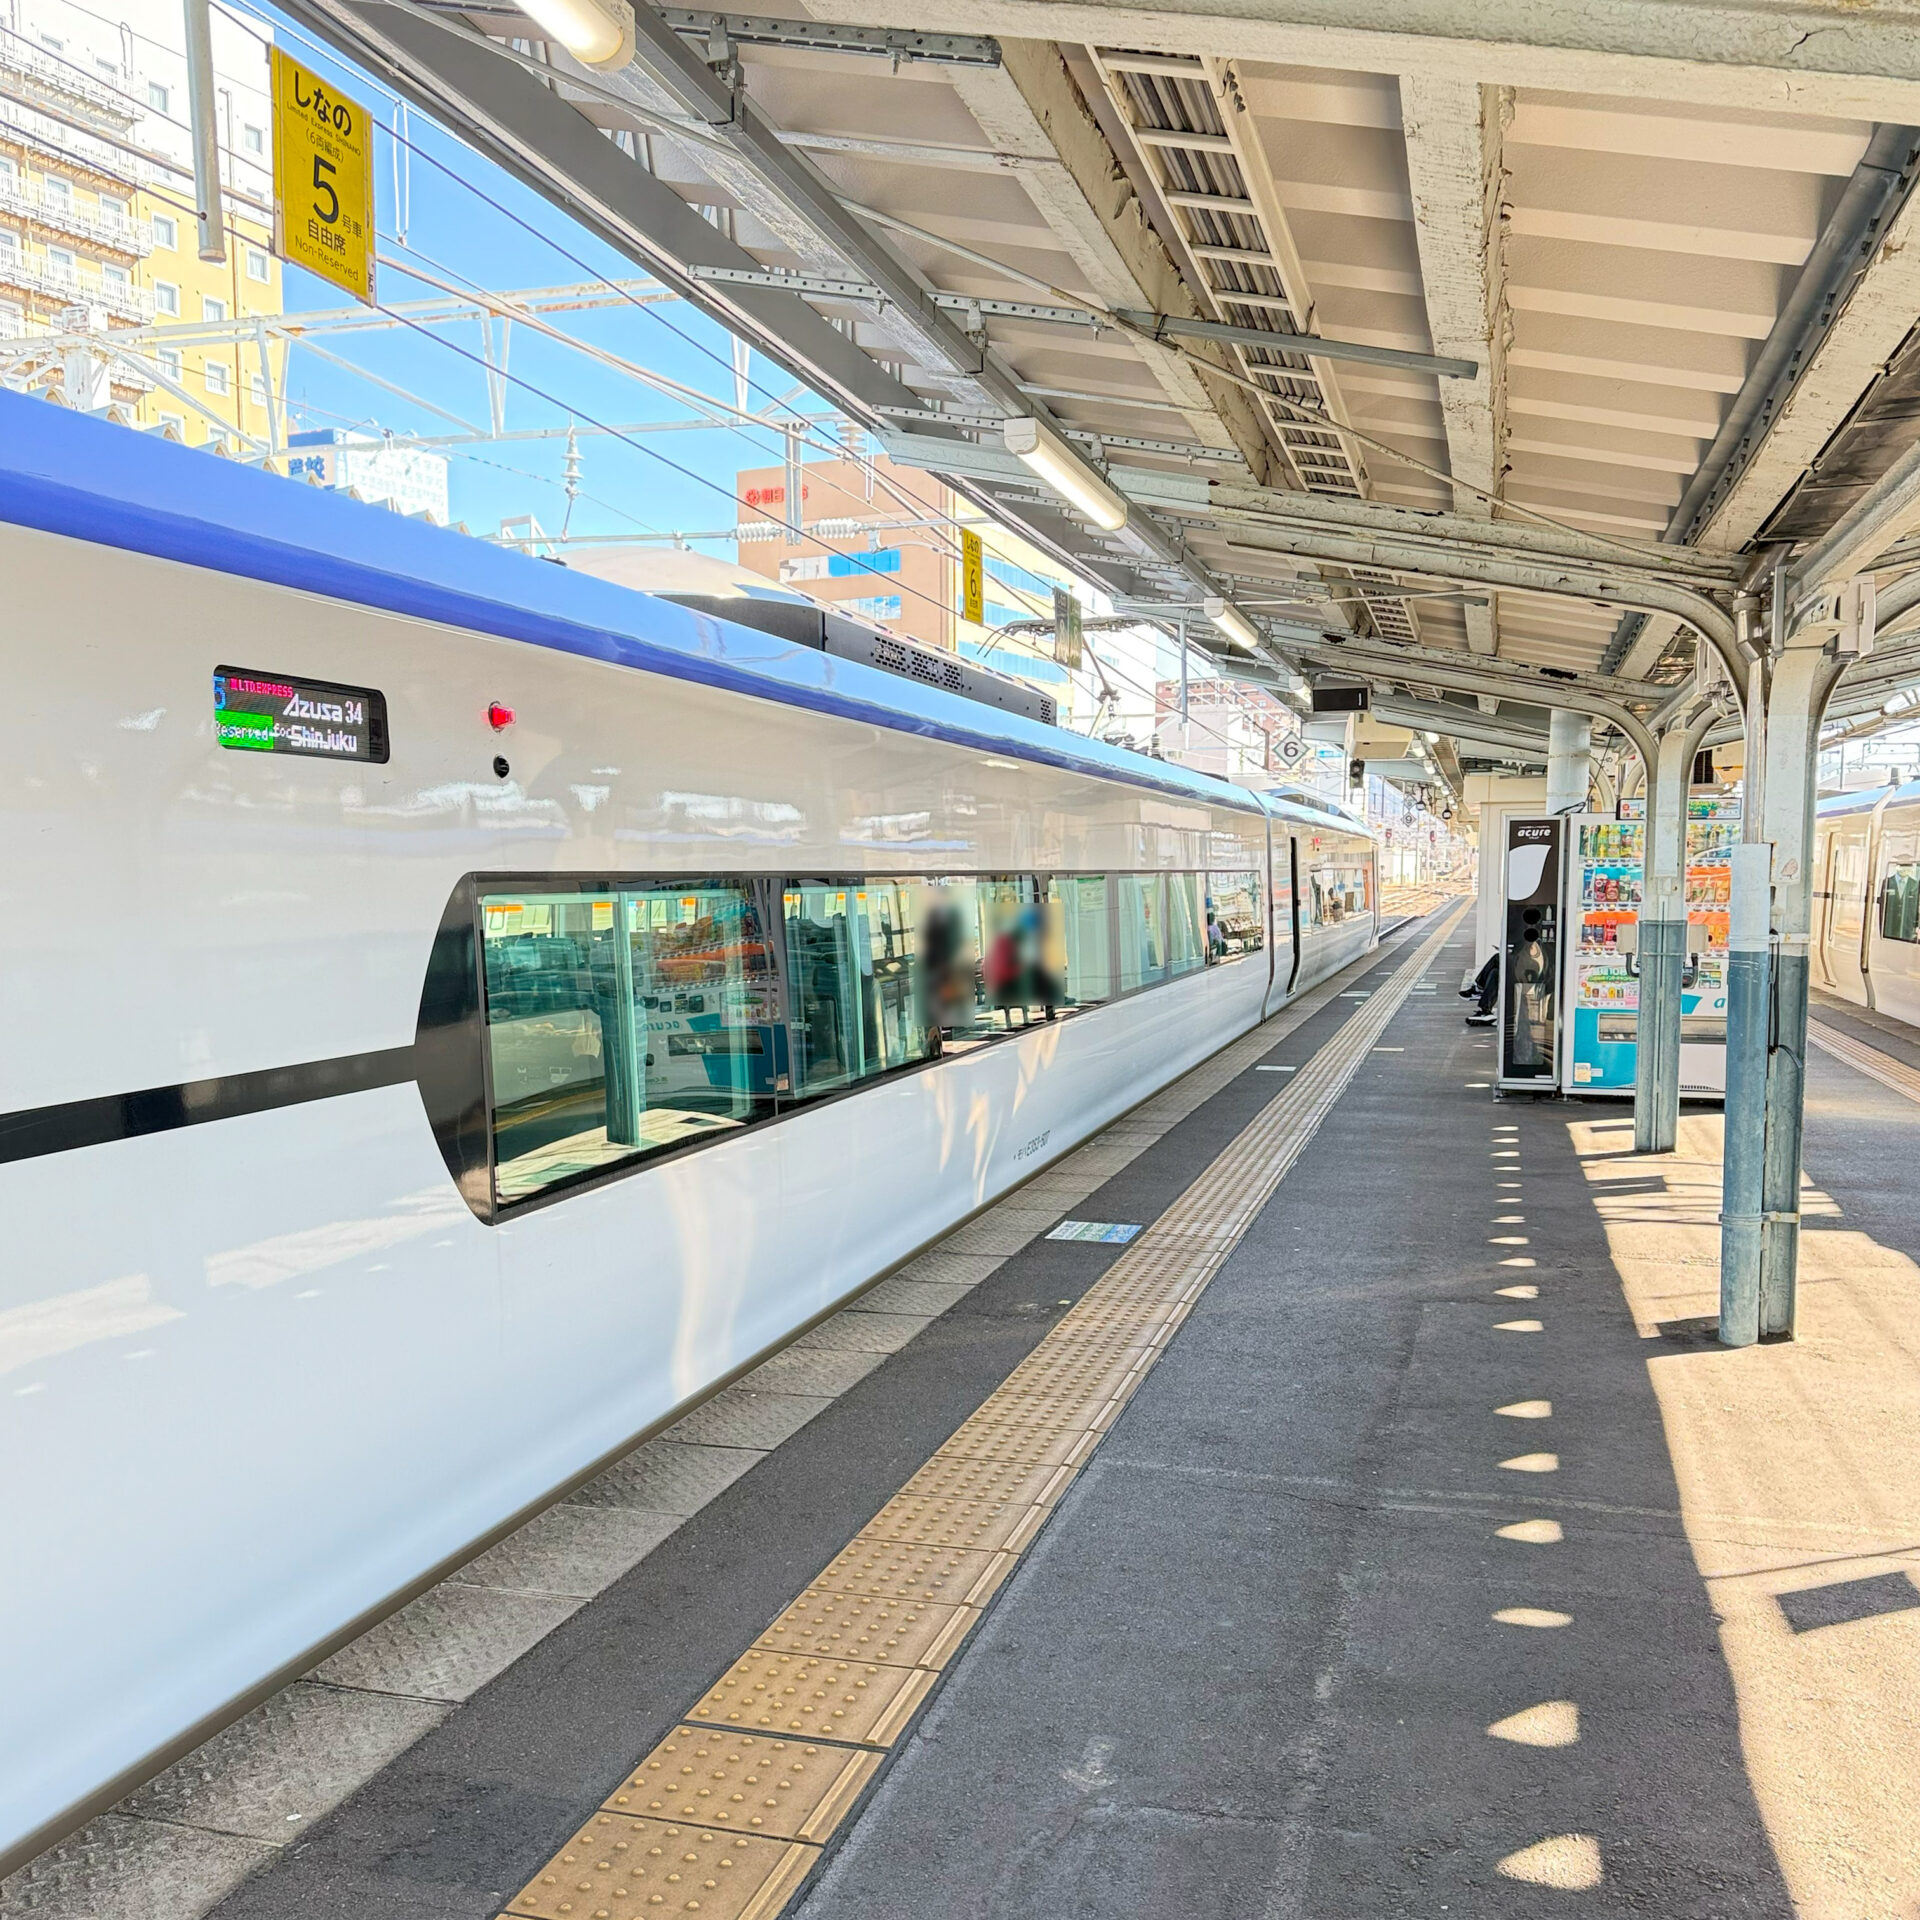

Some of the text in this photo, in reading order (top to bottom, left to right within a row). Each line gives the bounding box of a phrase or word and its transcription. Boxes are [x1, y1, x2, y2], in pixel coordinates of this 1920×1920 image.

[294, 70, 352, 137] しなの
[311, 117, 333, 138] Express
[313, 154, 362, 239] 5 号車
[308, 218, 346, 256] 自由席
[295, 235, 359, 281] Non-Reserved
[970, 568, 977, 598] 6
[213, 675, 226, 710] 5
[282, 693, 363, 725] Azusa 34
[290, 724, 358, 752] Shinjuku
[1283, 741, 1299, 758] 6
[1517, 828, 1552, 837] acure
